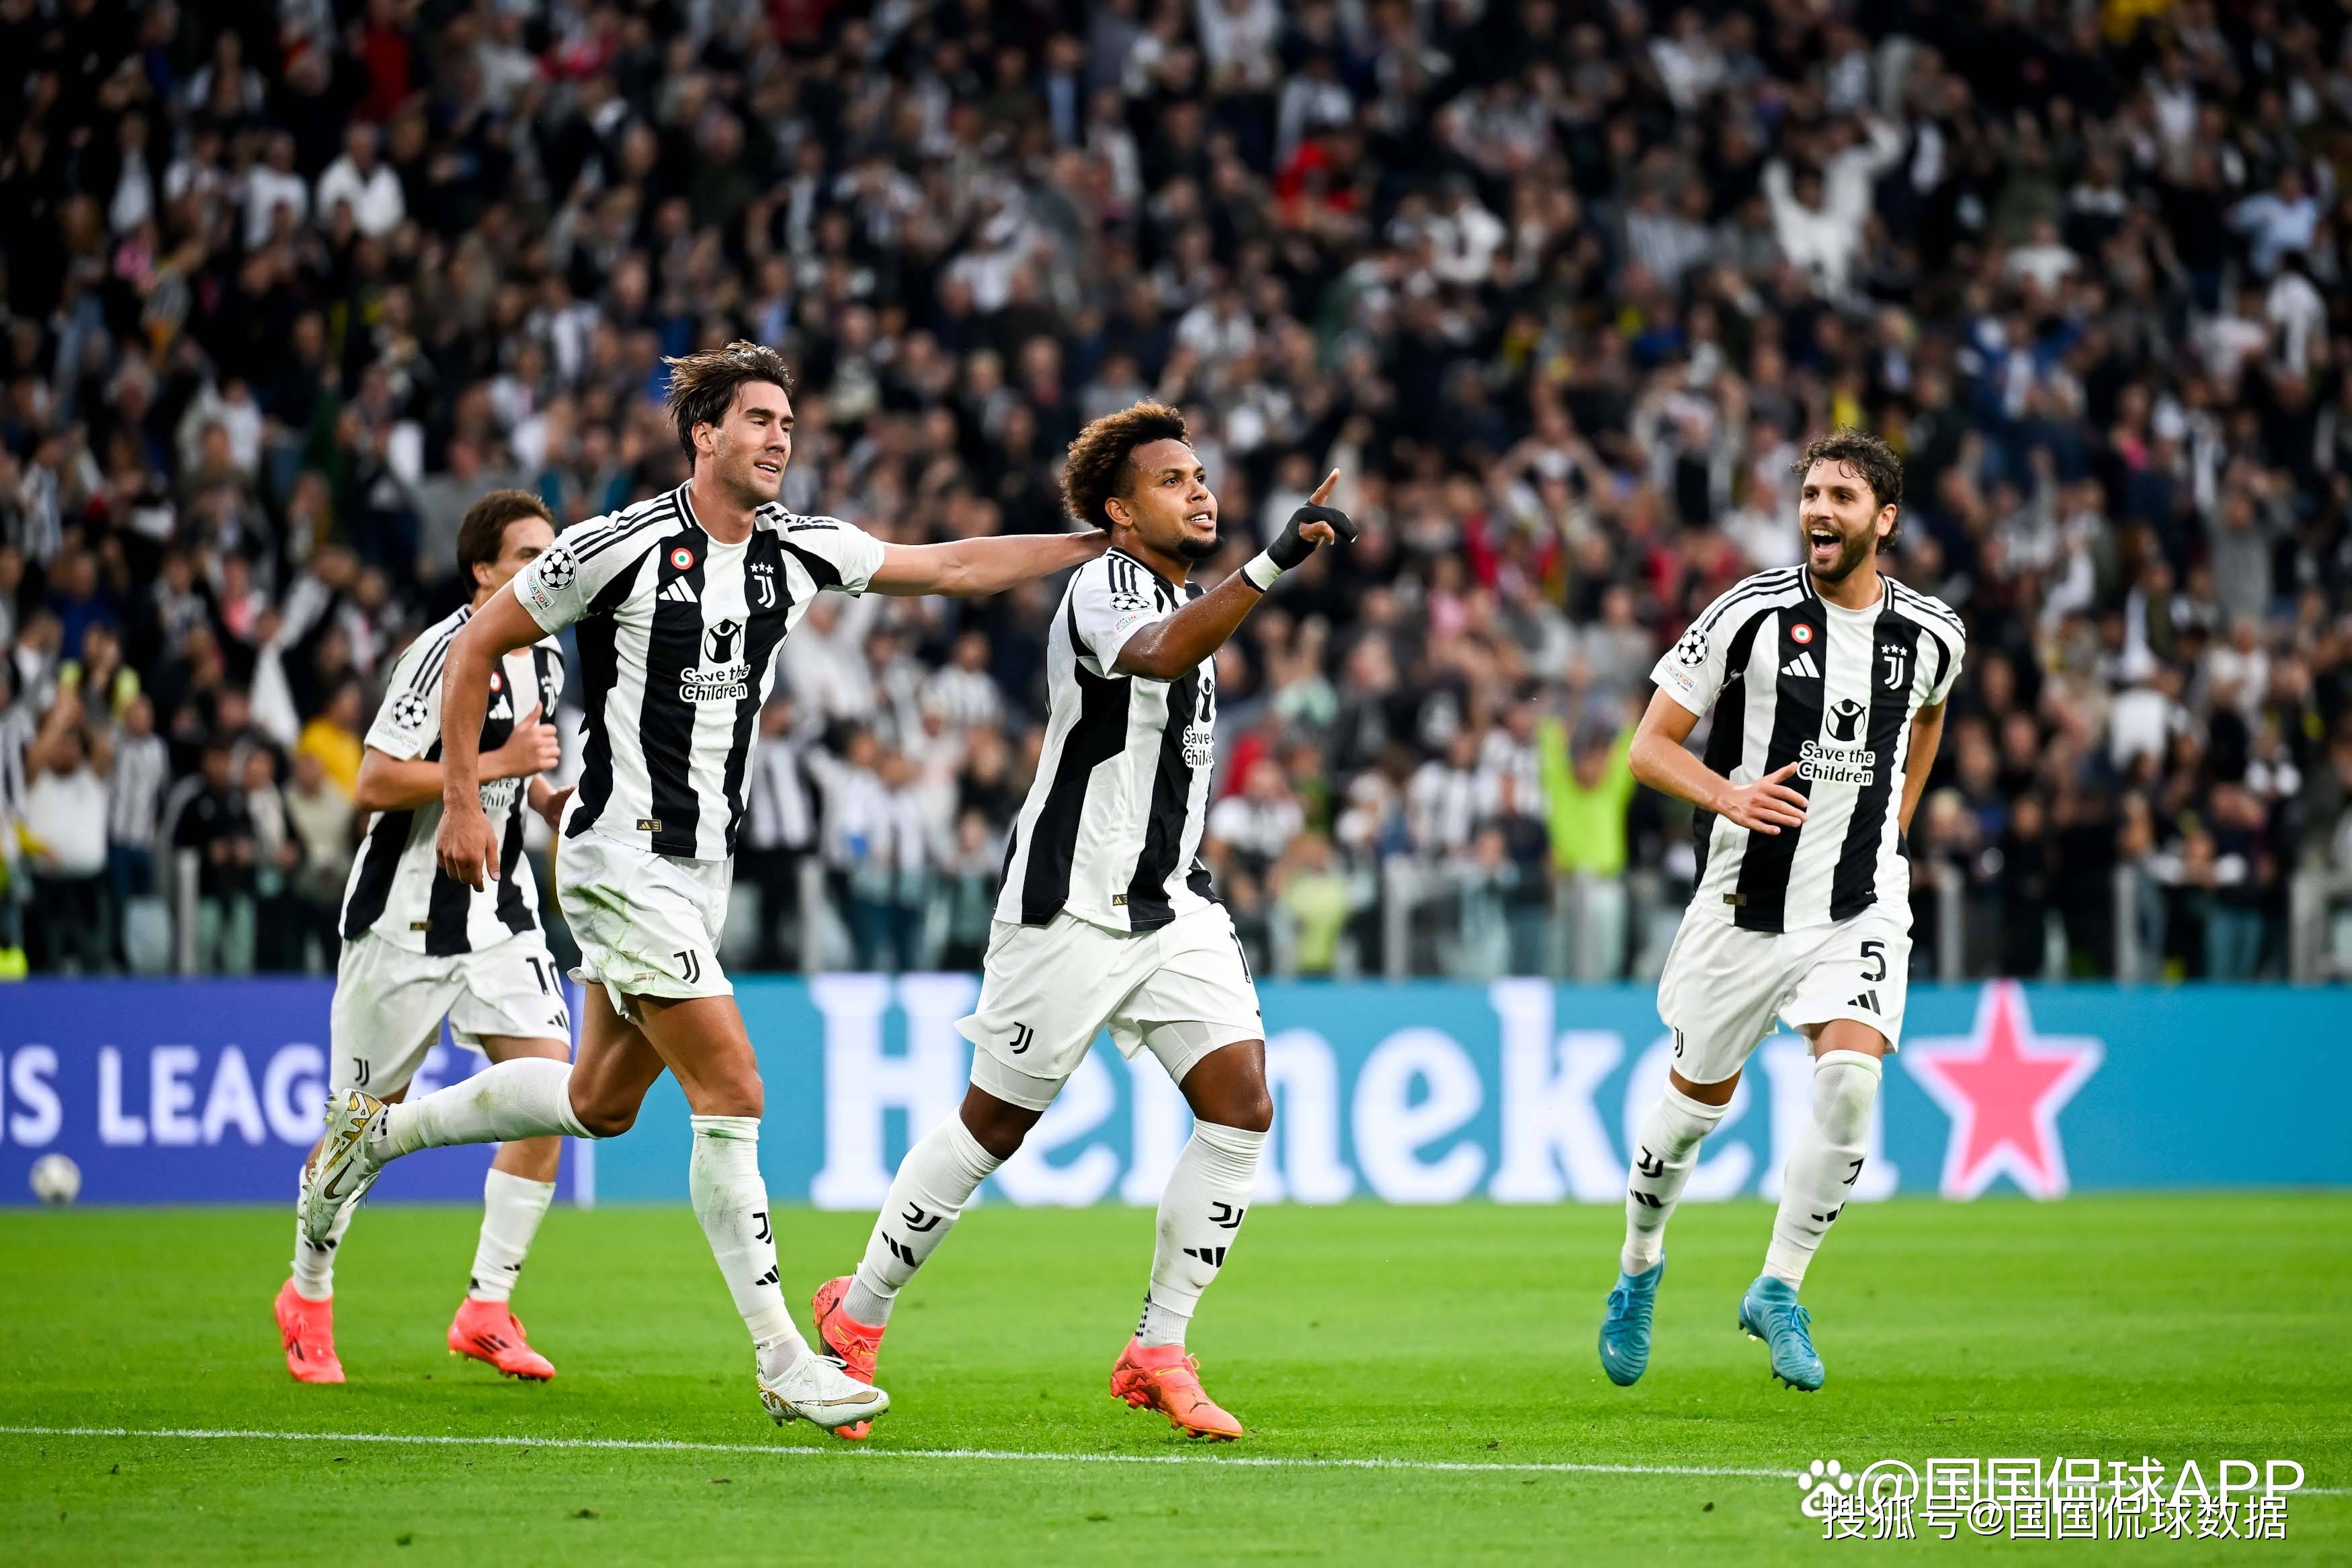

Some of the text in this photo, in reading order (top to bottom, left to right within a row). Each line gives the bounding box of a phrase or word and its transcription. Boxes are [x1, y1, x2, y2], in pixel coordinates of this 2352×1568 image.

[683, 664, 749, 682] Save the
[682, 684, 745, 701] Children
[1185, 727, 1210, 744] Save
[1802, 742, 1873, 763] Save the
[1799, 762, 1872, 783] Children
[1860, 941, 1886, 982] 5
